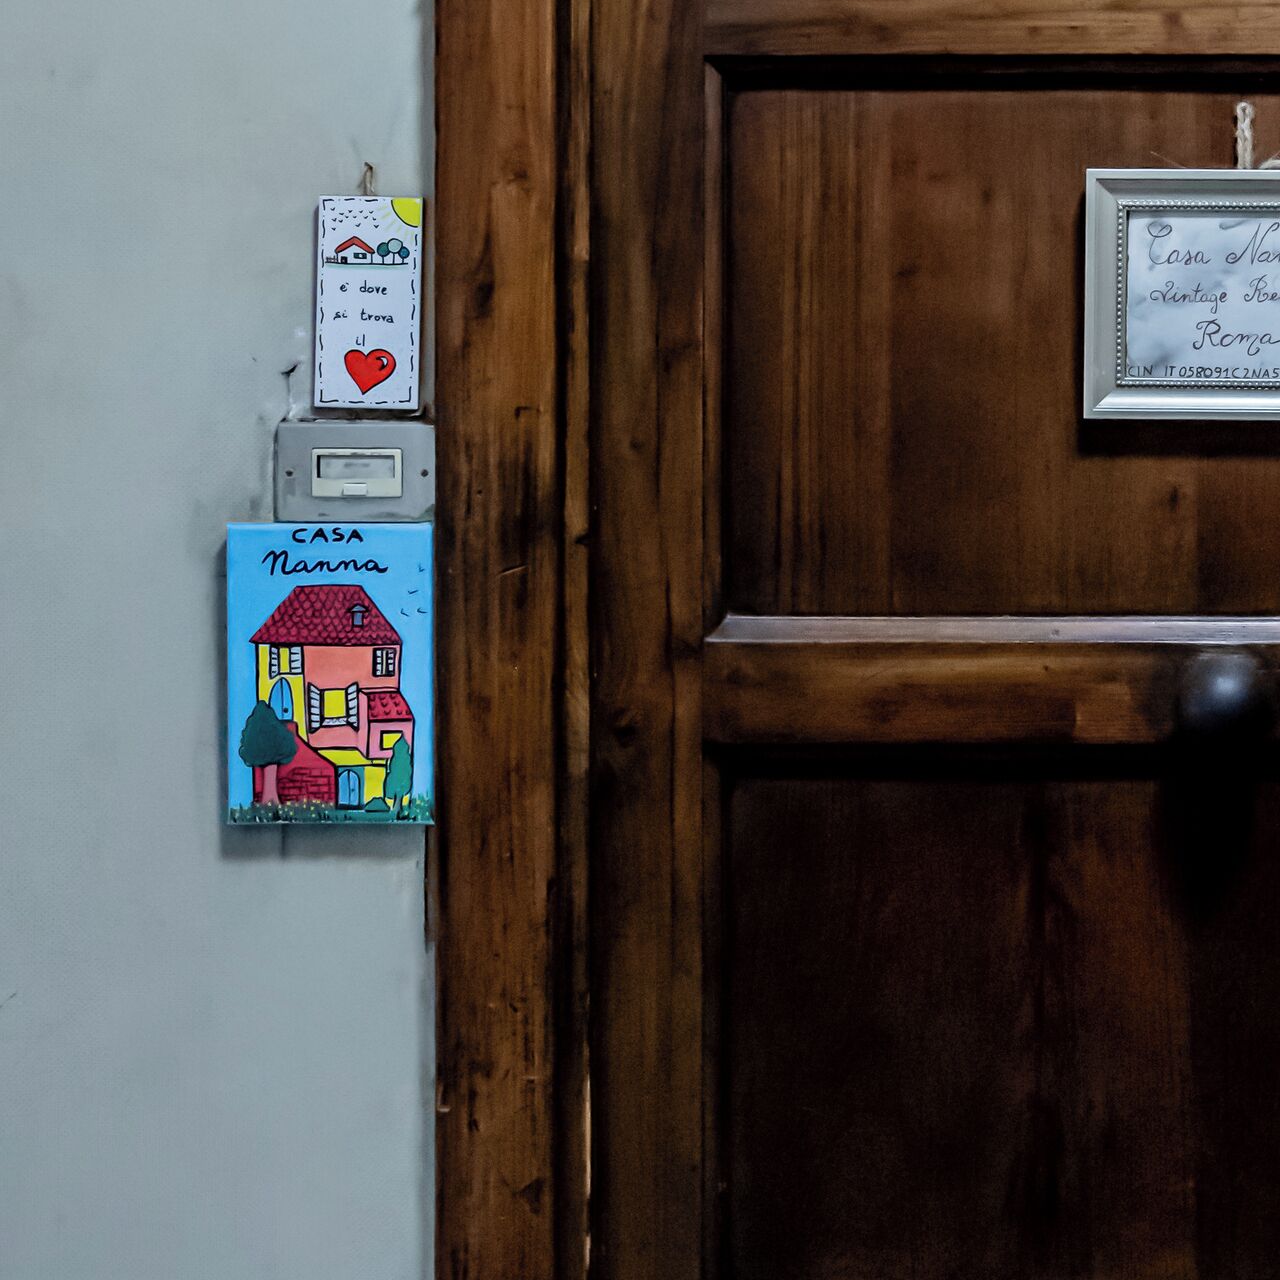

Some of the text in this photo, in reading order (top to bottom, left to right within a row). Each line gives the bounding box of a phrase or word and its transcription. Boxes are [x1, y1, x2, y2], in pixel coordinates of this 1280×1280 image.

[1146, 221, 1212, 265] Casa
[359, 279, 388, 296] dove
[1149, 280, 1228, 314] Vintage
[333, 307, 395, 324] si trova
[355, 333, 366, 347] il
[1127, 365, 1154, 378] CIN
[291, 527, 364, 544] CASA
[261, 549, 389, 576] Nanna
